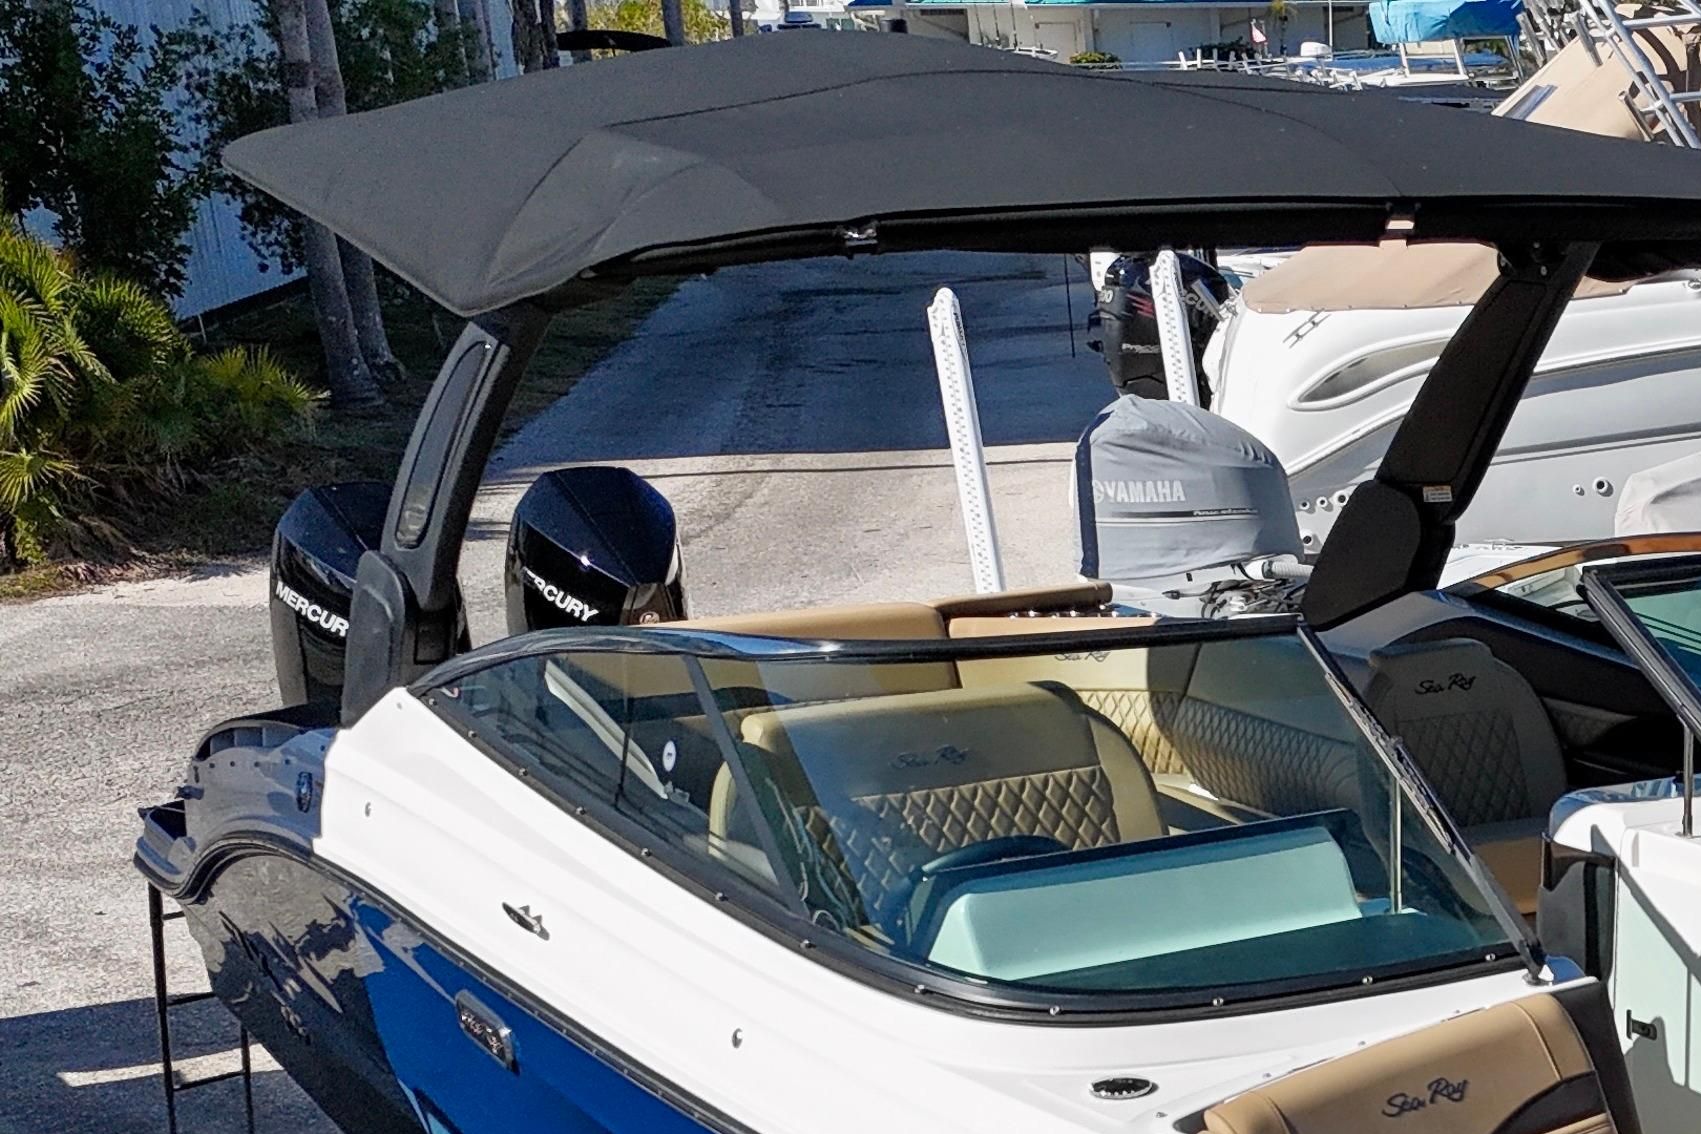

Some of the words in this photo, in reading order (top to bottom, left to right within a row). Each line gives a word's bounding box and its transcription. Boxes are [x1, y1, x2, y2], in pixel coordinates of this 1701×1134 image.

[1105, 479, 1186, 503] YAMAHA
[275, 580, 350, 637] MERCUR
[1414, 679, 1445, 695] Sea
[1447, 672, 1477, 691] Ray
[1381, 1092, 1426, 1118] Sea
[1427, 1077, 1470, 1105] Ray
